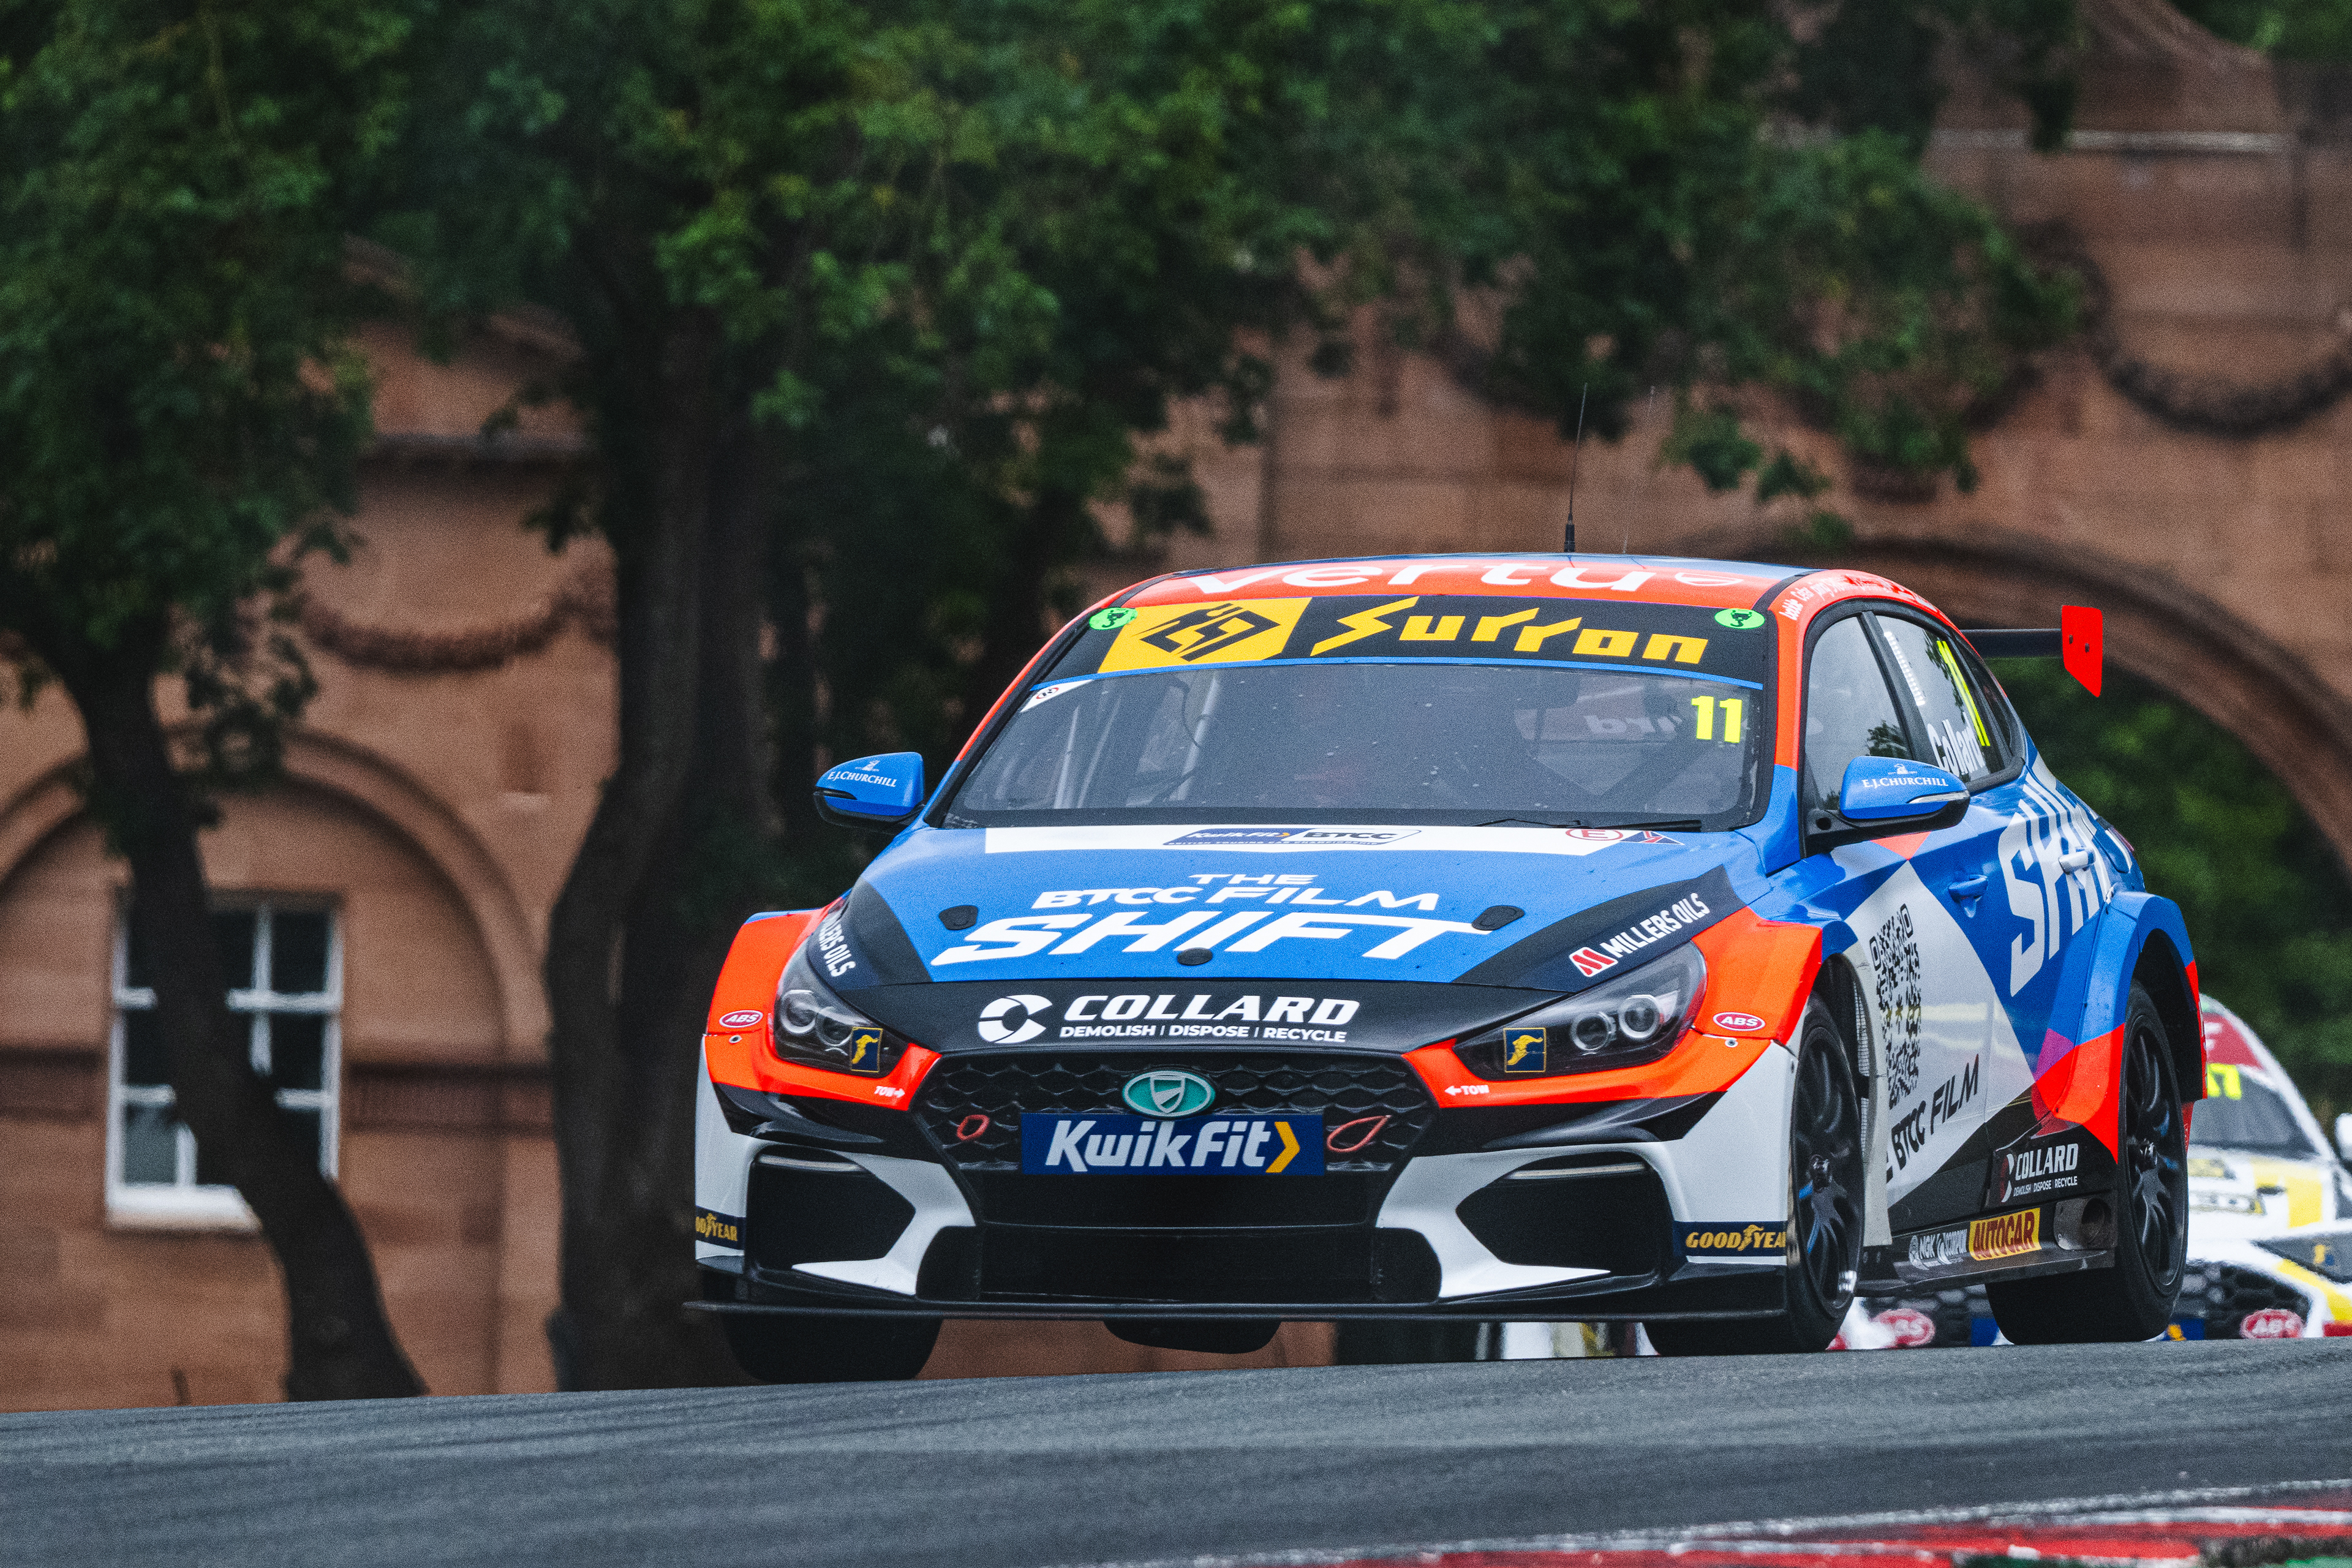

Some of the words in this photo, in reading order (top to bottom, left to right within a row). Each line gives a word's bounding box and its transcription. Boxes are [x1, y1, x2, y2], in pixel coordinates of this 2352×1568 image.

[1937, 641, 1990, 746] 11
[1691, 696, 1742, 743] 11
[1928, 712, 1986, 779] Collard
[1189, 874, 1318, 884] THE
[1031, 887, 1204, 909] BTCC
[1205, 887, 1439, 910] FILM
[931, 911, 1491, 966] SHIFT
[1600, 910, 1683, 958] MILLERS
[1672, 892, 1710, 923] OILS
[824, 944, 856, 977] OILS
[725, 1014, 760, 1023] ABS
[1064, 995, 1360, 1025] COLLARD
[1720, 1016, 1759, 1027] ABS
[1060, 1025, 1160, 1038] DEMOLISH
[1169, 1025, 1248, 1038] DISPOSE
[1264, 1027, 1348, 1042] RECYCLE
[1460, 1084, 1490, 1095] TOW
[1891, 1100, 1926, 1170] BTCC
[1931, 1053, 1979, 1136] FILM
[2015, 1143, 2079, 1181] COLLARD
[2033, 1180, 2052, 1193] DISPOSE
[2054, 1176, 2078, 1188] RECYCLE
[1686, 1227, 1786, 1250] GOODYEA
[1973, 1211, 2035, 1259] AUTOCAR
